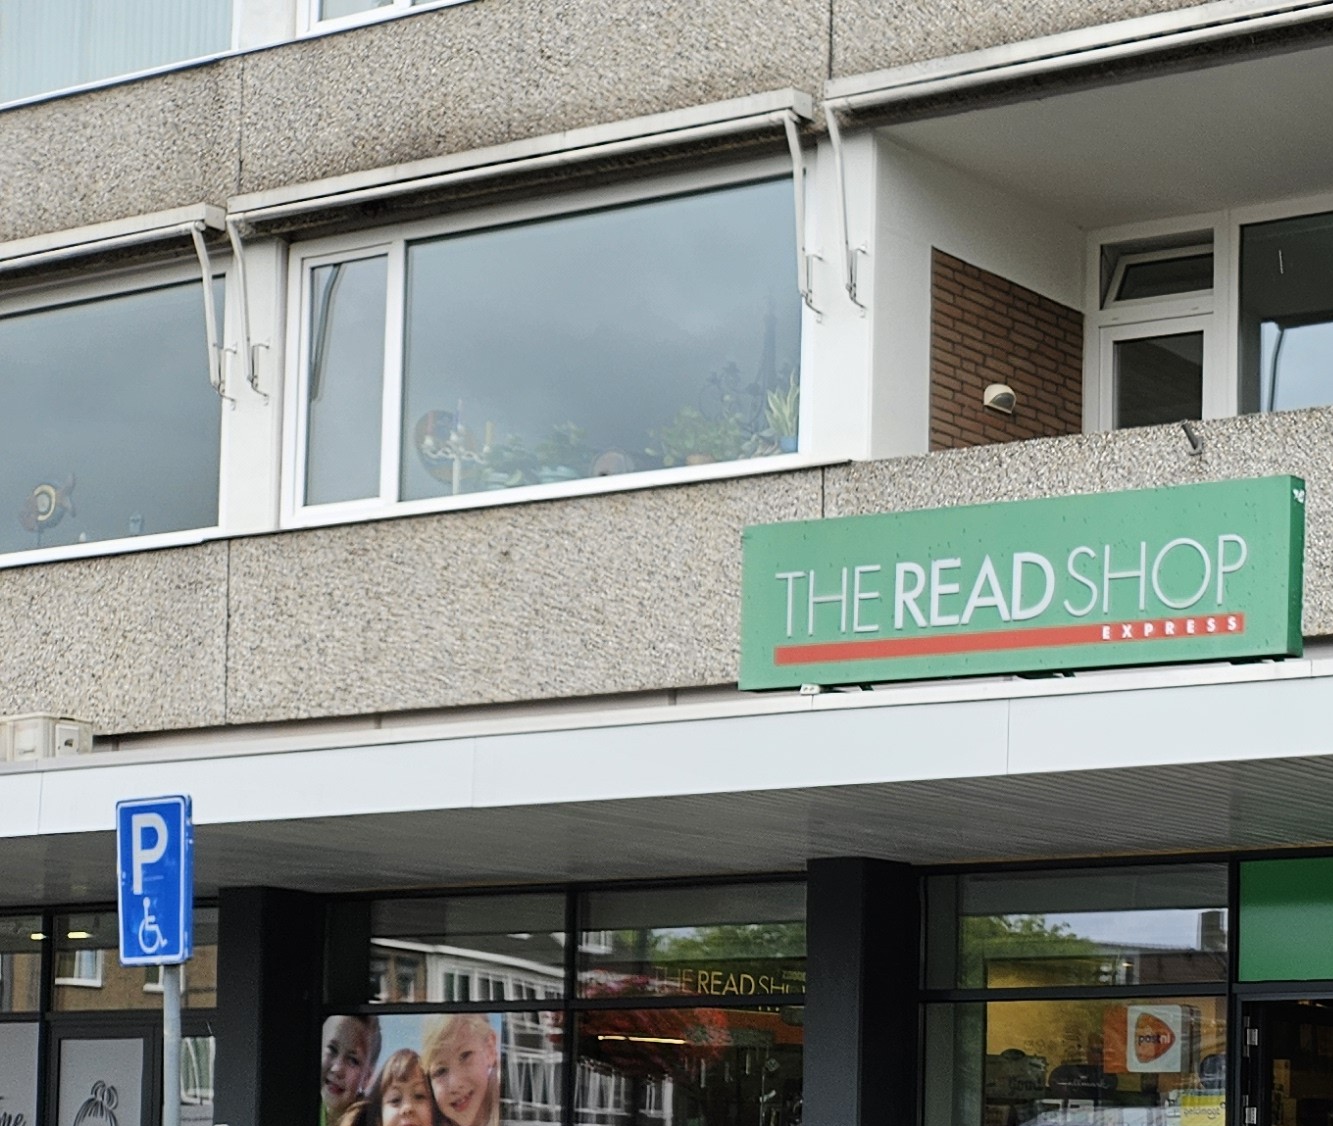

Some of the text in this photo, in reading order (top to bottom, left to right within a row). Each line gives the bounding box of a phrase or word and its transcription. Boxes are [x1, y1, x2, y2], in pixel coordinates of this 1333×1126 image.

[775, 533, 1249, 638] THE READ SHOP
[1102, 614, 1238, 641] EXPRESS
[132, 813, 168, 895] P
[697, 970, 756, 995] READ
